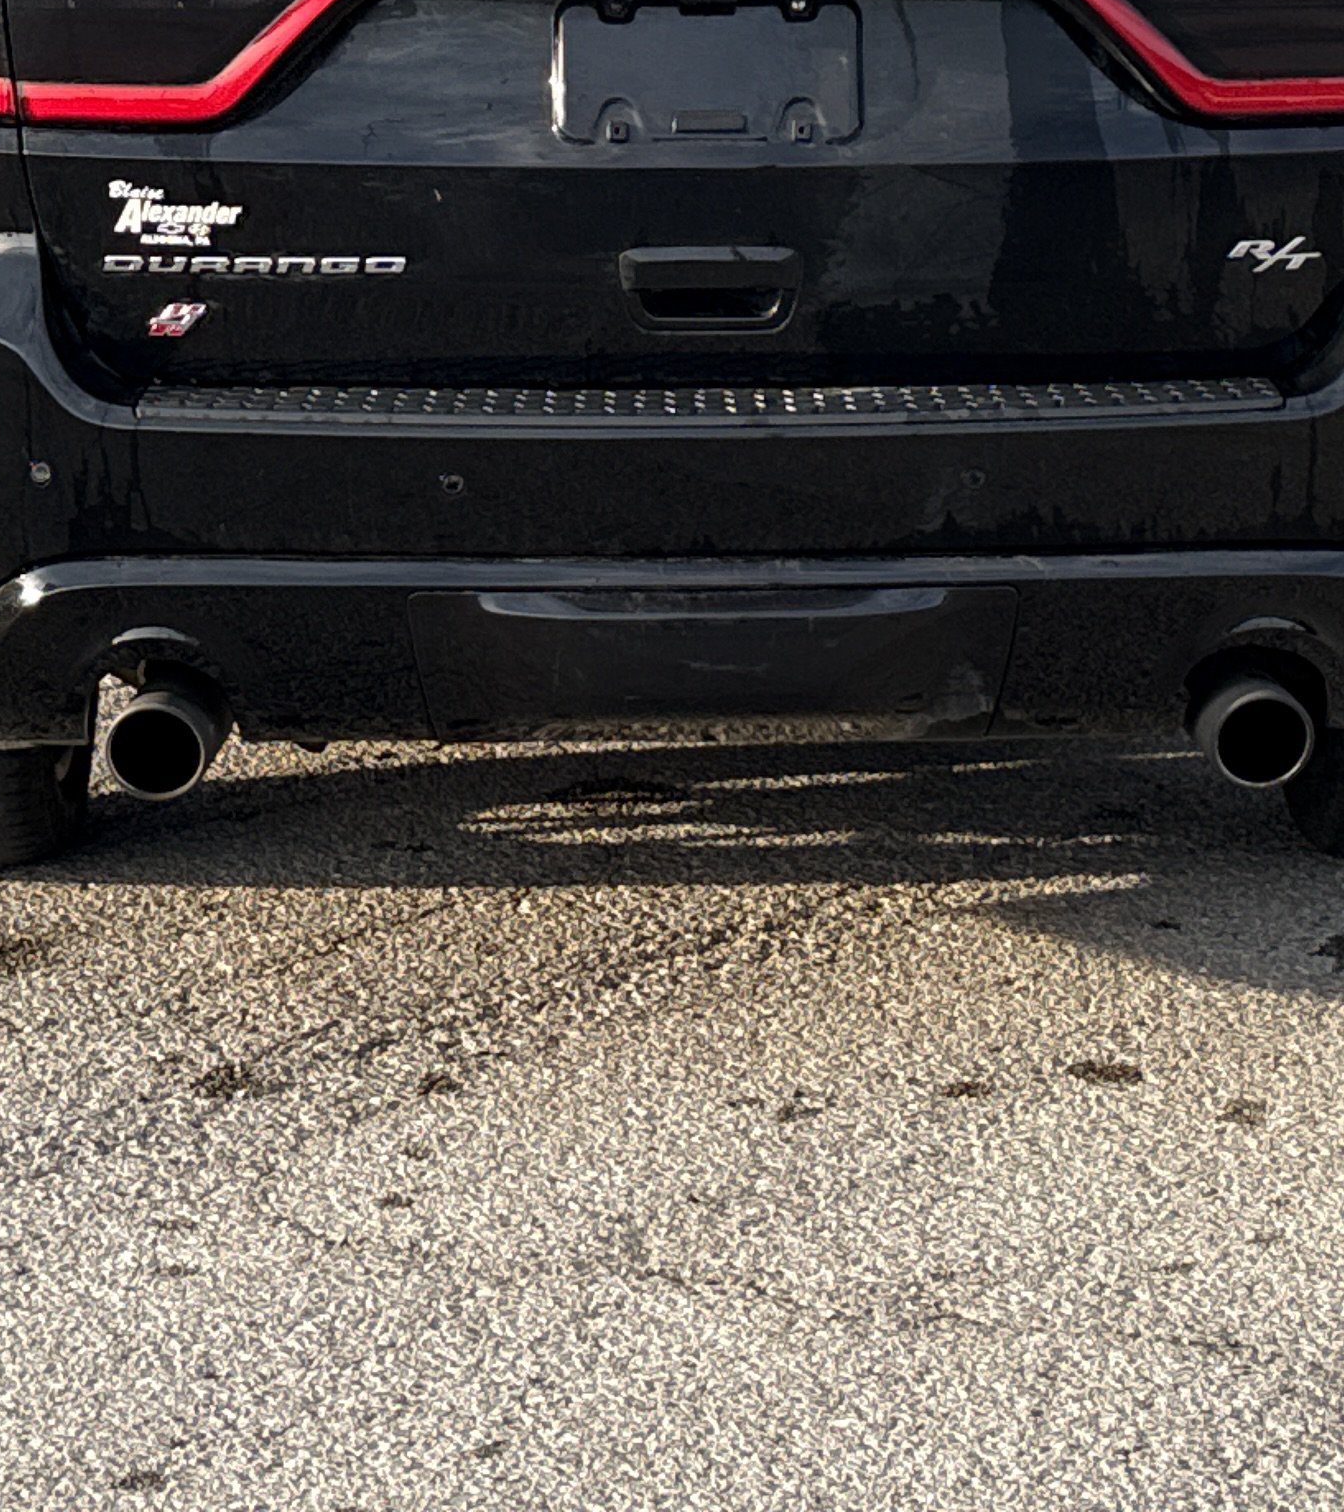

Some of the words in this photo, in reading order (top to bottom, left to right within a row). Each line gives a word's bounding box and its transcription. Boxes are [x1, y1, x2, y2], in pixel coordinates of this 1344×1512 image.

[114, 199, 243, 234] Alexander
[102, 254, 406, 275] DURANGO
[1226, 236, 1323, 273] R/T
